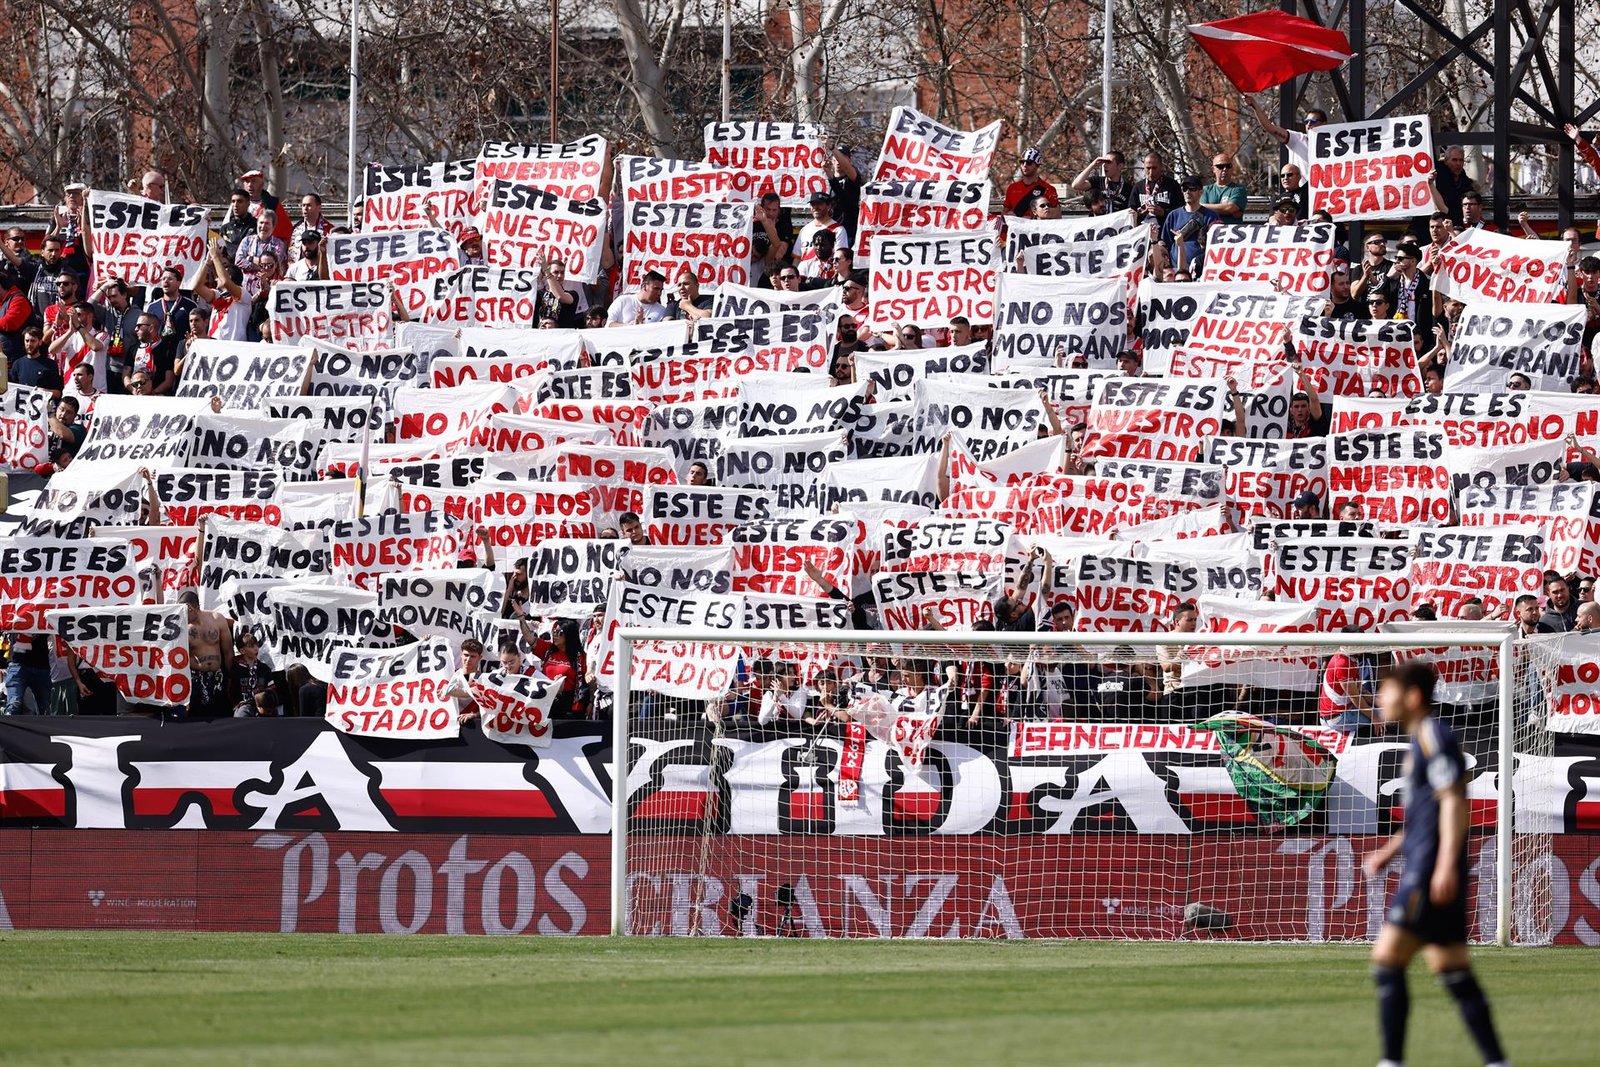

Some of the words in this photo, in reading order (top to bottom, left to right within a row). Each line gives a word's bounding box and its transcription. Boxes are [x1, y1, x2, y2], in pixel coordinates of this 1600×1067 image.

[896, 109, 965, 152] ESTE
[972, 126, 998, 154] ES
[1315, 126, 1382, 158] ESTE
[1392, 120, 1423, 148] ES
[482, 141, 554, 160] ESTE
[559, 138, 598, 159] ES
[708, 144, 826, 170] NUESTRO
[367, 162, 432, 196] ESTE
[444, 159, 476, 182] ES
[476, 160, 600, 181] NUESTRO
[1309, 152, 1433, 188] NUESTRO
[492, 179, 558, 211] ESTE
[568, 197, 603, 216] ES
[946, 181, 984, 204] ES
[1312, 181, 1431, 215] ESTADIO
[92, 201, 161, 230] ESTE
[169, 205, 205, 226] ES
[485, 211, 598, 248] NUESTRO
[632, 201, 705, 228] ESTE
[712, 203, 750, 230] ES
[860, 201, 984, 230] NUESTRO
[90, 232, 204, 261] NUESTRO
[334, 236, 408, 264] ESTE
[418, 230, 451, 253] ES
[626, 230, 751, 259] NUESTRO
[1209, 224, 1280, 244] ESTE
[1293, 222, 1332, 244] ES
[880, 241, 950, 265] ESTE
[961, 239, 992, 265] ES
[1036, 249, 1104, 277] ESTE
[1116, 237, 1146, 268] ES
[1203, 246, 1335, 268] NUESTRO
[498, 269, 533, 292] ES
[873, 267, 995, 294] NUESTRO
[275, 284, 343, 313] ESTE
[351, 282, 384, 309] ES
[872, 295, 992, 322] ESTADIO
[1140, 295, 1197, 327] ¡NO
[1205, 292, 1277, 319] ESTE
[1284, 295, 1322, 320] ES
[273, 311, 390, 341] NUESTRO
[781, 313, 822, 343] ES
[996, 301, 1054, 330] ¡NO
[1063, 301, 1126, 326] NOS
[1300, 319, 1373, 342] ESTE
[1378, 320, 1414, 343] ES
[1459, 316, 1513, 338] ¡NO
[1520, 319, 1584, 345] NOS
[182, 352, 239, 382] ¡NO
[243, 355, 307, 383] NOS
[359, 353, 417, 381] NOS
[925, 349, 988, 379] NOS
[1298, 340, 1416, 369] NUESTRO
[1450, 342, 1580, 385] MOVERÁN!
[601, 371, 631, 397] ES
[1098, 381, 1170, 407] ESTE
[1174, 384, 1218, 410] ES
[14, 388, 43, 420] ES
[323, 406, 383, 431] NOS
[739, 403, 798, 425] ¡NO
[807, 395, 864, 424] NOS
[916, 403, 973, 432] ¡NO
[981, 406, 1040, 432] NOS
[1405, 392, 1477, 416] ESTE
[1488, 393, 1527, 417] ES
[88, 414, 140, 443] ¡NO
[1093, 409, 1220, 438] NUESTRO
[192, 427, 249, 458] ¡NO
[258, 437, 313, 469] NOS
[1210, 438, 1277, 467] ESTE
[1289, 443, 1327, 470] ES
[1334, 432, 1401, 461] ESTE
[1413, 431, 1443, 460] ES
[557, 453, 615, 482] ¡NO
[717, 451, 774, 481] ¡NO
[1329, 464, 1449, 492] NUESTRO
[157, 474, 230, 501] ESTE
[243, 472, 278, 500] ES
[1084, 477, 1145, 506] NOS
[1180, 468, 1221, 499] ES
[1465, 484, 1540, 511] ESTE
[1550, 484, 1588, 511] ES
[475, 492, 527, 523] ¡NO
[535, 492, 591, 516] NOS
[652, 492, 724, 518] ESTE
[734, 494, 770, 520] ES
[810, 519, 851, 543] ES
[974, 521, 1009, 546] ES
[1, 547, 78, 573] ESTE
[87, 545, 127, 573] ES
[204, 534, 262, 564] ¡NO
[268, 548, 325, 573] NOS
[333, 535, 456, 568] NUESTRO
[528, 545, 579, 578] ¡NO
[1280, 545, 1356, 572] ESTE
[1368, 545, 1408, 571] ES
[1417, 532, 1493, 561] ESTE
[1501, 534, 1544, 563] ES
[0, 575, 136, 600] NUESTRO
[671, 568, 731, 595] NOS
[877, 572, 947, 603] ESTE
[1079, 554, 1154, 585] ESTE
[1163, 558, 1198, 592] ES
[1207, 566, 1262, 591] NOS
[1411, 561, 1542, 592] NUESTRO
[377, 578, 433, 606] ¡NO
[445, 581, 503, 613] NOS
[1275, 575, 1410, 602] NUESTRO
[273, 602, 329, 635] ¡NO
[337, 607, 391, 637] NOS
[619, 588, 697, 625] ESTE
[705, 601, 736, 629] ES
[816, 602, 847, 629] ES
[58, 614, 132, 641] ESTE
[143, 613, 181, 641] ES
[416, 644, 448, 673] ES
[253, 831, 589, 936] Protos
